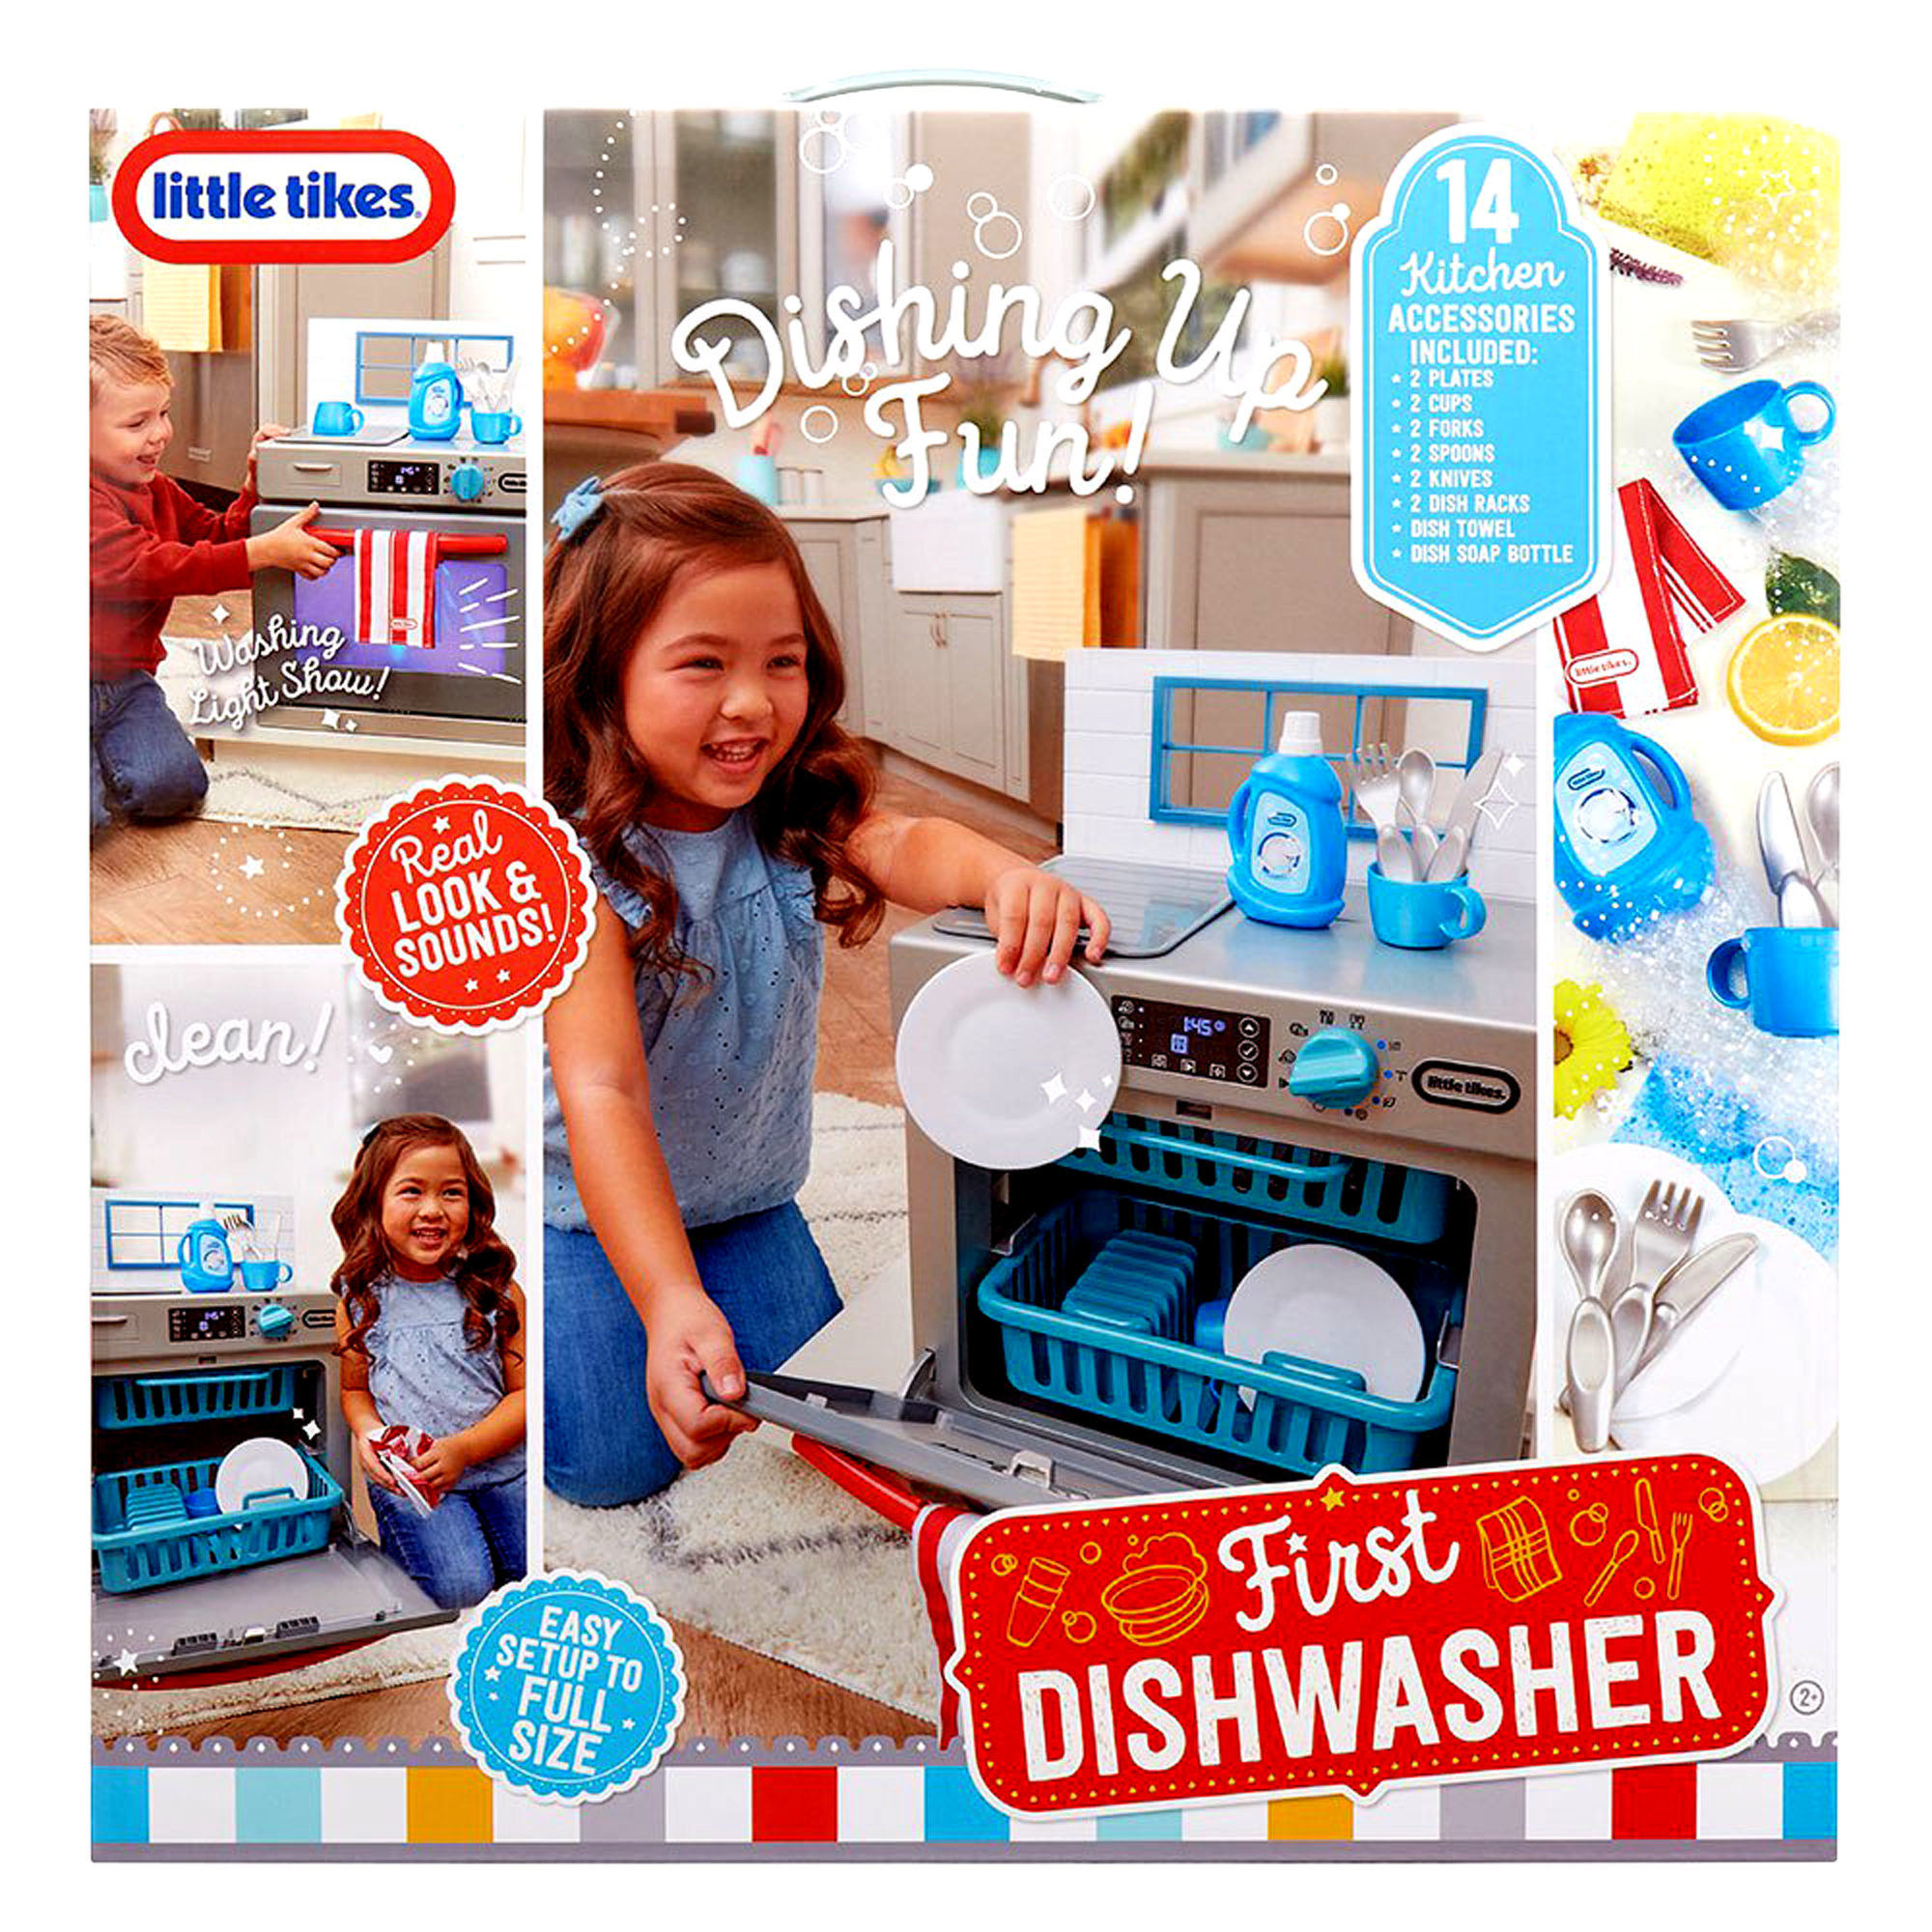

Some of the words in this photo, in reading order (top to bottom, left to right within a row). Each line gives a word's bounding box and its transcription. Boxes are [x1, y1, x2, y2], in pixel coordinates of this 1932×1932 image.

[153, 171, 276, 219] little
[1436, 157, 1520, 244] 14
[1400, 246, 1566, 298] Kitchen
[671, 239, 1131, 429] Dishing
[1155, 259, 1329, 442] Up
[1388, 303, 1576, 333] ACCESSORIES
[1409, 339, 1538, 365] INCLUDED:
[1409, 369, 1421, 387] 2
[1429, 369, 1493, 387] PLATES
[1409, 394, 1421, 412] 2
[1429, 394, 1472, 412] CUPS
[1409, 418, 1421, 438] 2
[1429, 418, 1484, 438] FORKS
[865, 372, 1155, 508] Fun!
[1409, 443, 1421, 463] 2
[1429, 443, 1495, 463] SPOONS
[1409, 469, 1421, 488] 2
[1429, 469, 1492, 488] KNIVES
[1409, 495, 1421, 513] 2
[1429, 495, 1467, 513] DISH
[1474, 495, 1530, 513] RACKS
[1410, 519, 1449, 538] DISH
[1456, 519, 1515, 538] TOWEL
[1410, 544, 1449, 563] DISH
[1457, 544, 1500, 563] SOAP
[1508, 544, 1574, 563] BOTTLE
[191, 613, 346, 675] Washing
[188, 675, 280, 730] Light
[281, 656, 391, 700] Show!
[390, 809, 503, 884] Real
[391, 868, 502, 933] LOOK
[505, 861, 542, 903] &
[393, 903, 557, 978] SOUNDS!
[124, 1001, 333, 1084] clean!
[1427, 1075, 1463, 1093] little
[1218, 1489, 1460, 1633] First
[539, 1605, 623, 1651] EASY
[496, 1634, 600, 1682] SETUP
[607, 1654, 643, 1692] TO
[518, 1674, 612, 1733] FULL
[1018, 1609, 1720, 1782] DISHWASHER
[508, 1719, 603, 1776] SIZE
